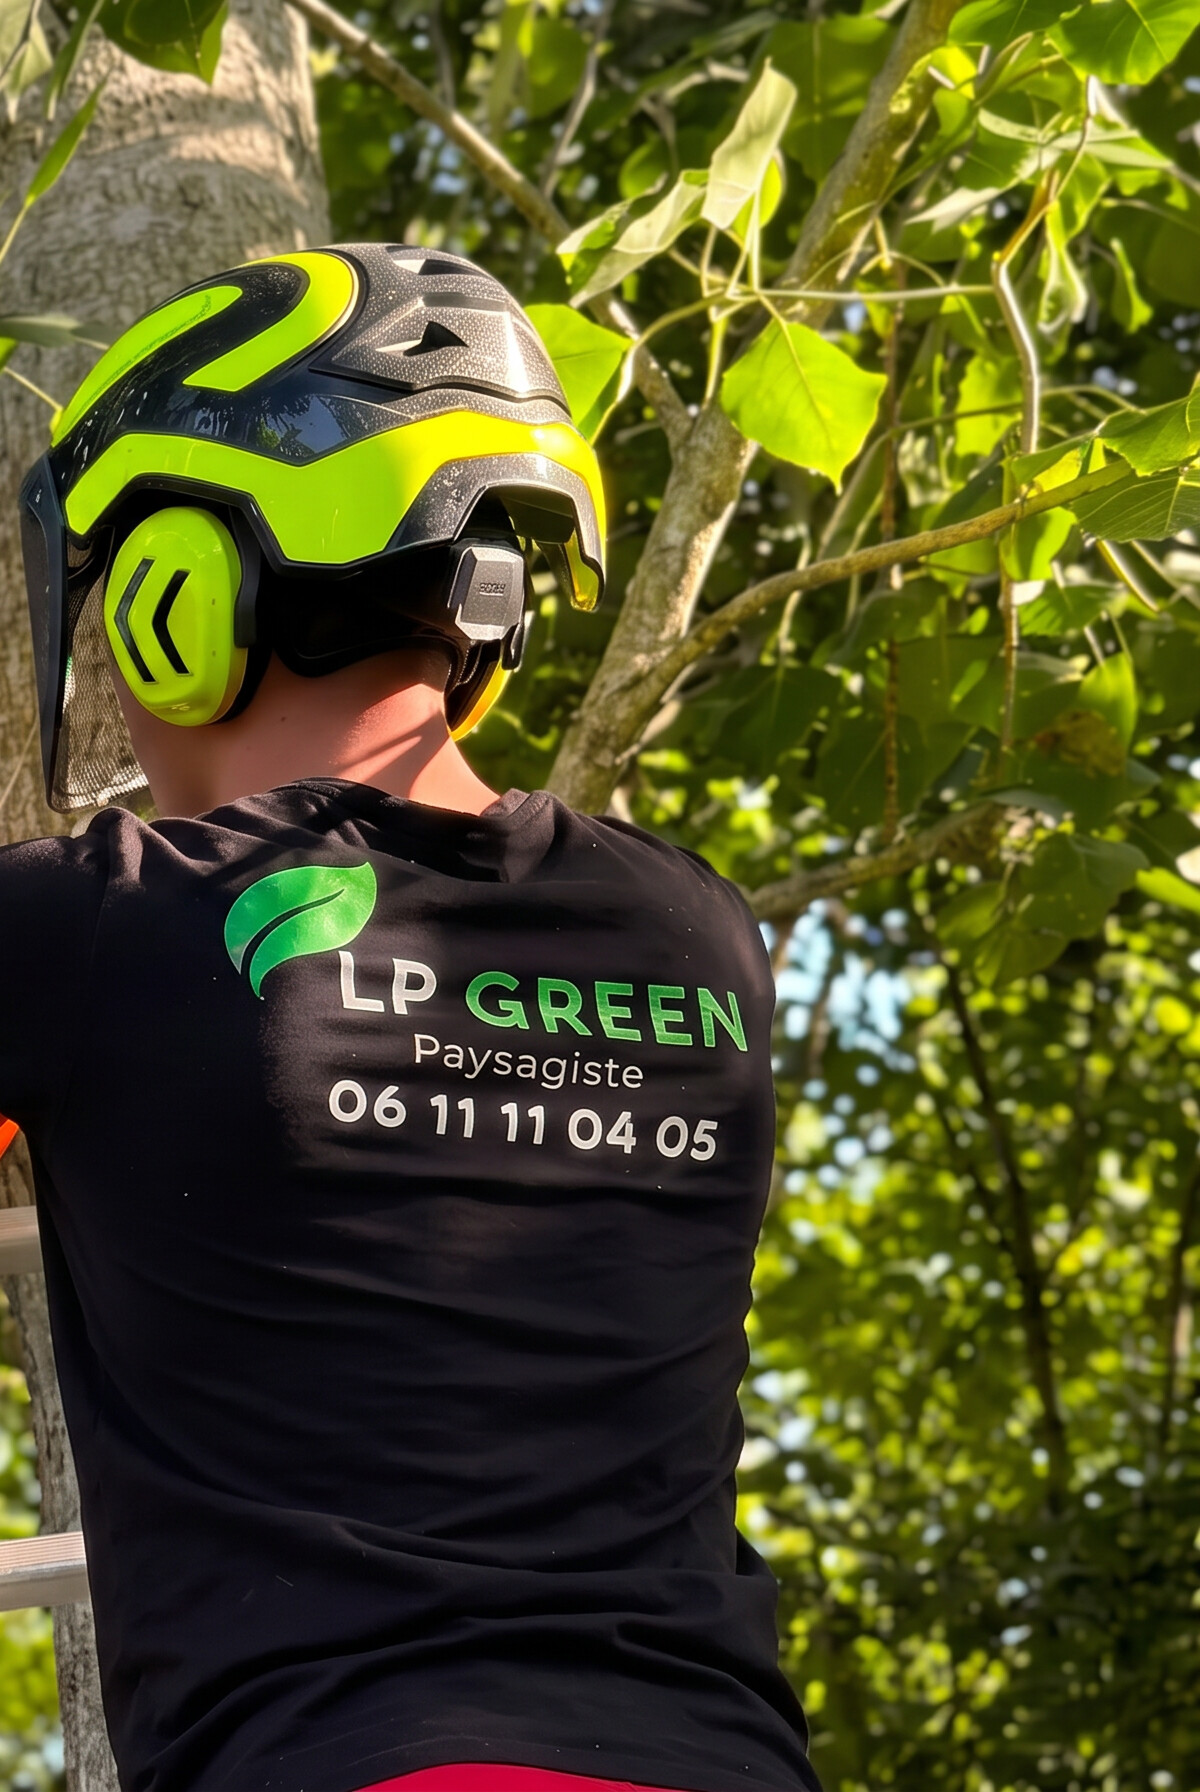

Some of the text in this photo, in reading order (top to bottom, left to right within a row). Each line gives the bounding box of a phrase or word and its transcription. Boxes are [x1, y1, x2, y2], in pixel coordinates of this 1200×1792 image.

[338, 951, 748, 1052] LP GREEN
[413, 1033, 644, 1090] Paysagiste
[328, 1079, 718, 1161] 06 11 11 04 05
